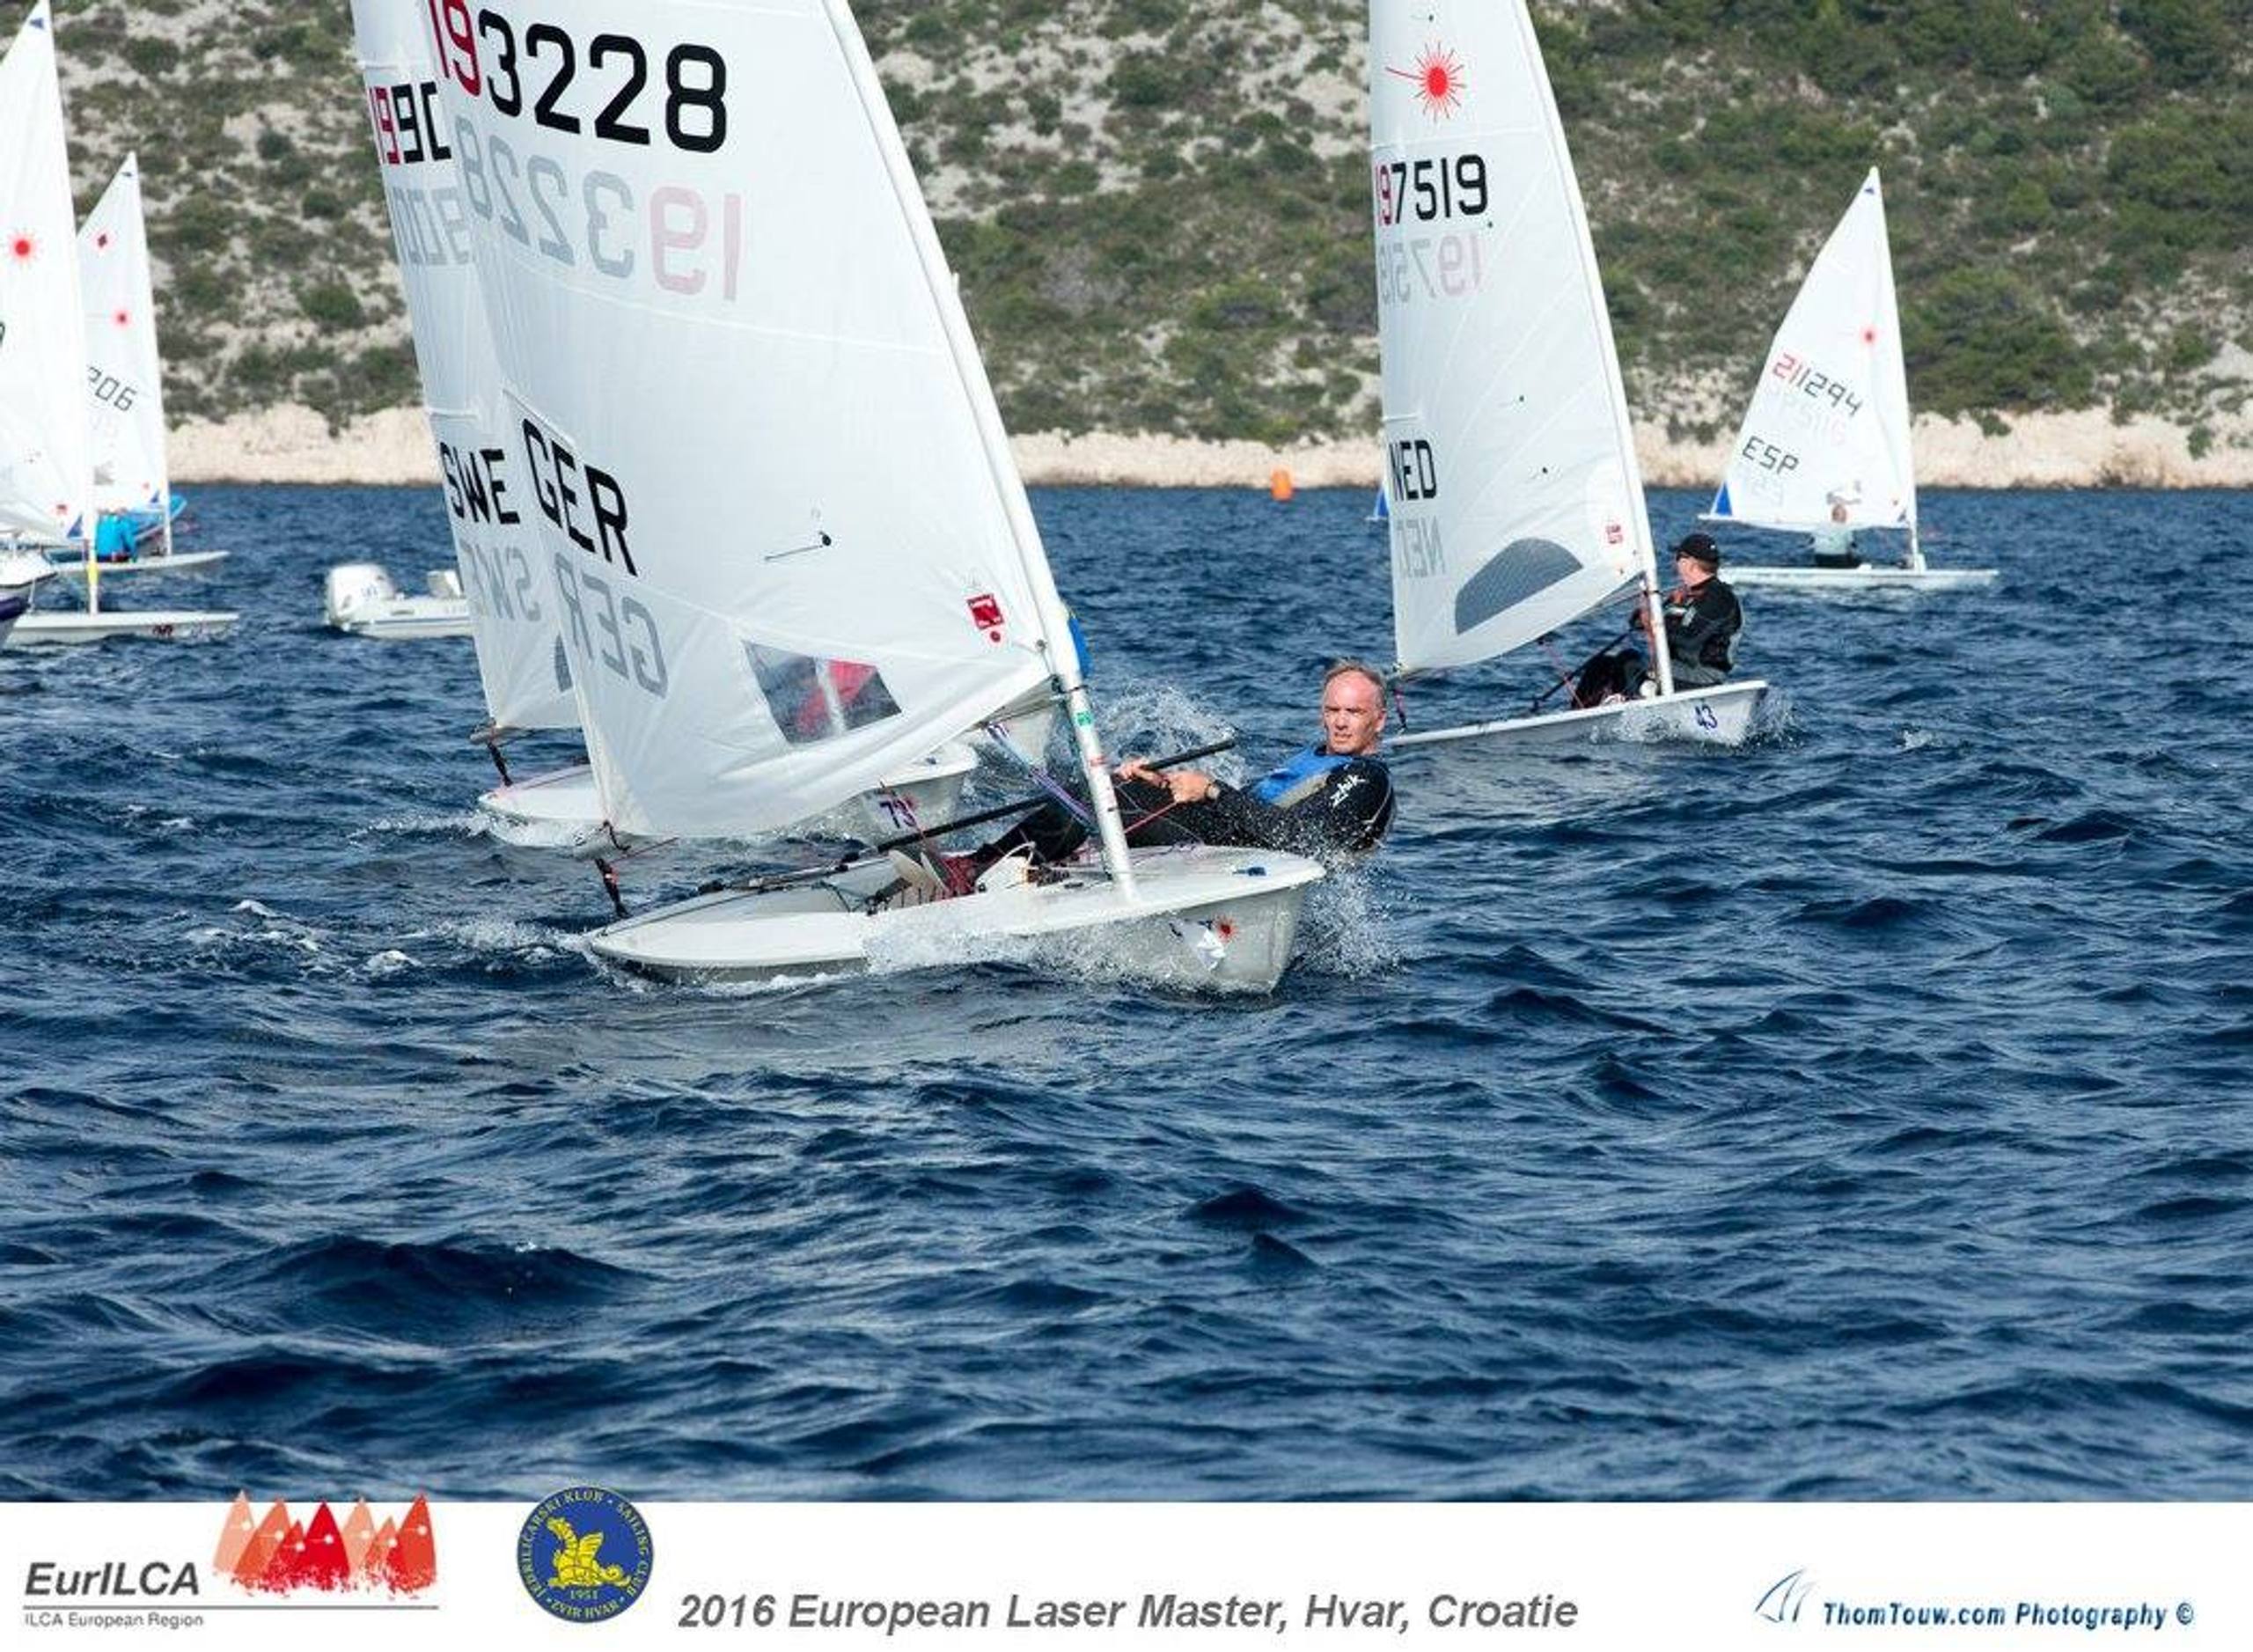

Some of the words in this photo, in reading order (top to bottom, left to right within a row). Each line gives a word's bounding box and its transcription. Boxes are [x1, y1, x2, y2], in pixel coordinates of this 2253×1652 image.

[429, 0, 726, 153] 193228
[440, 442, 520, 525] SWE
[1389, 439, 1437, 501] NED
[1742, 436, 1799, 474] ESP
[522, 417, 638, 577] GER
[1695, 704, 1718, 731] 43
